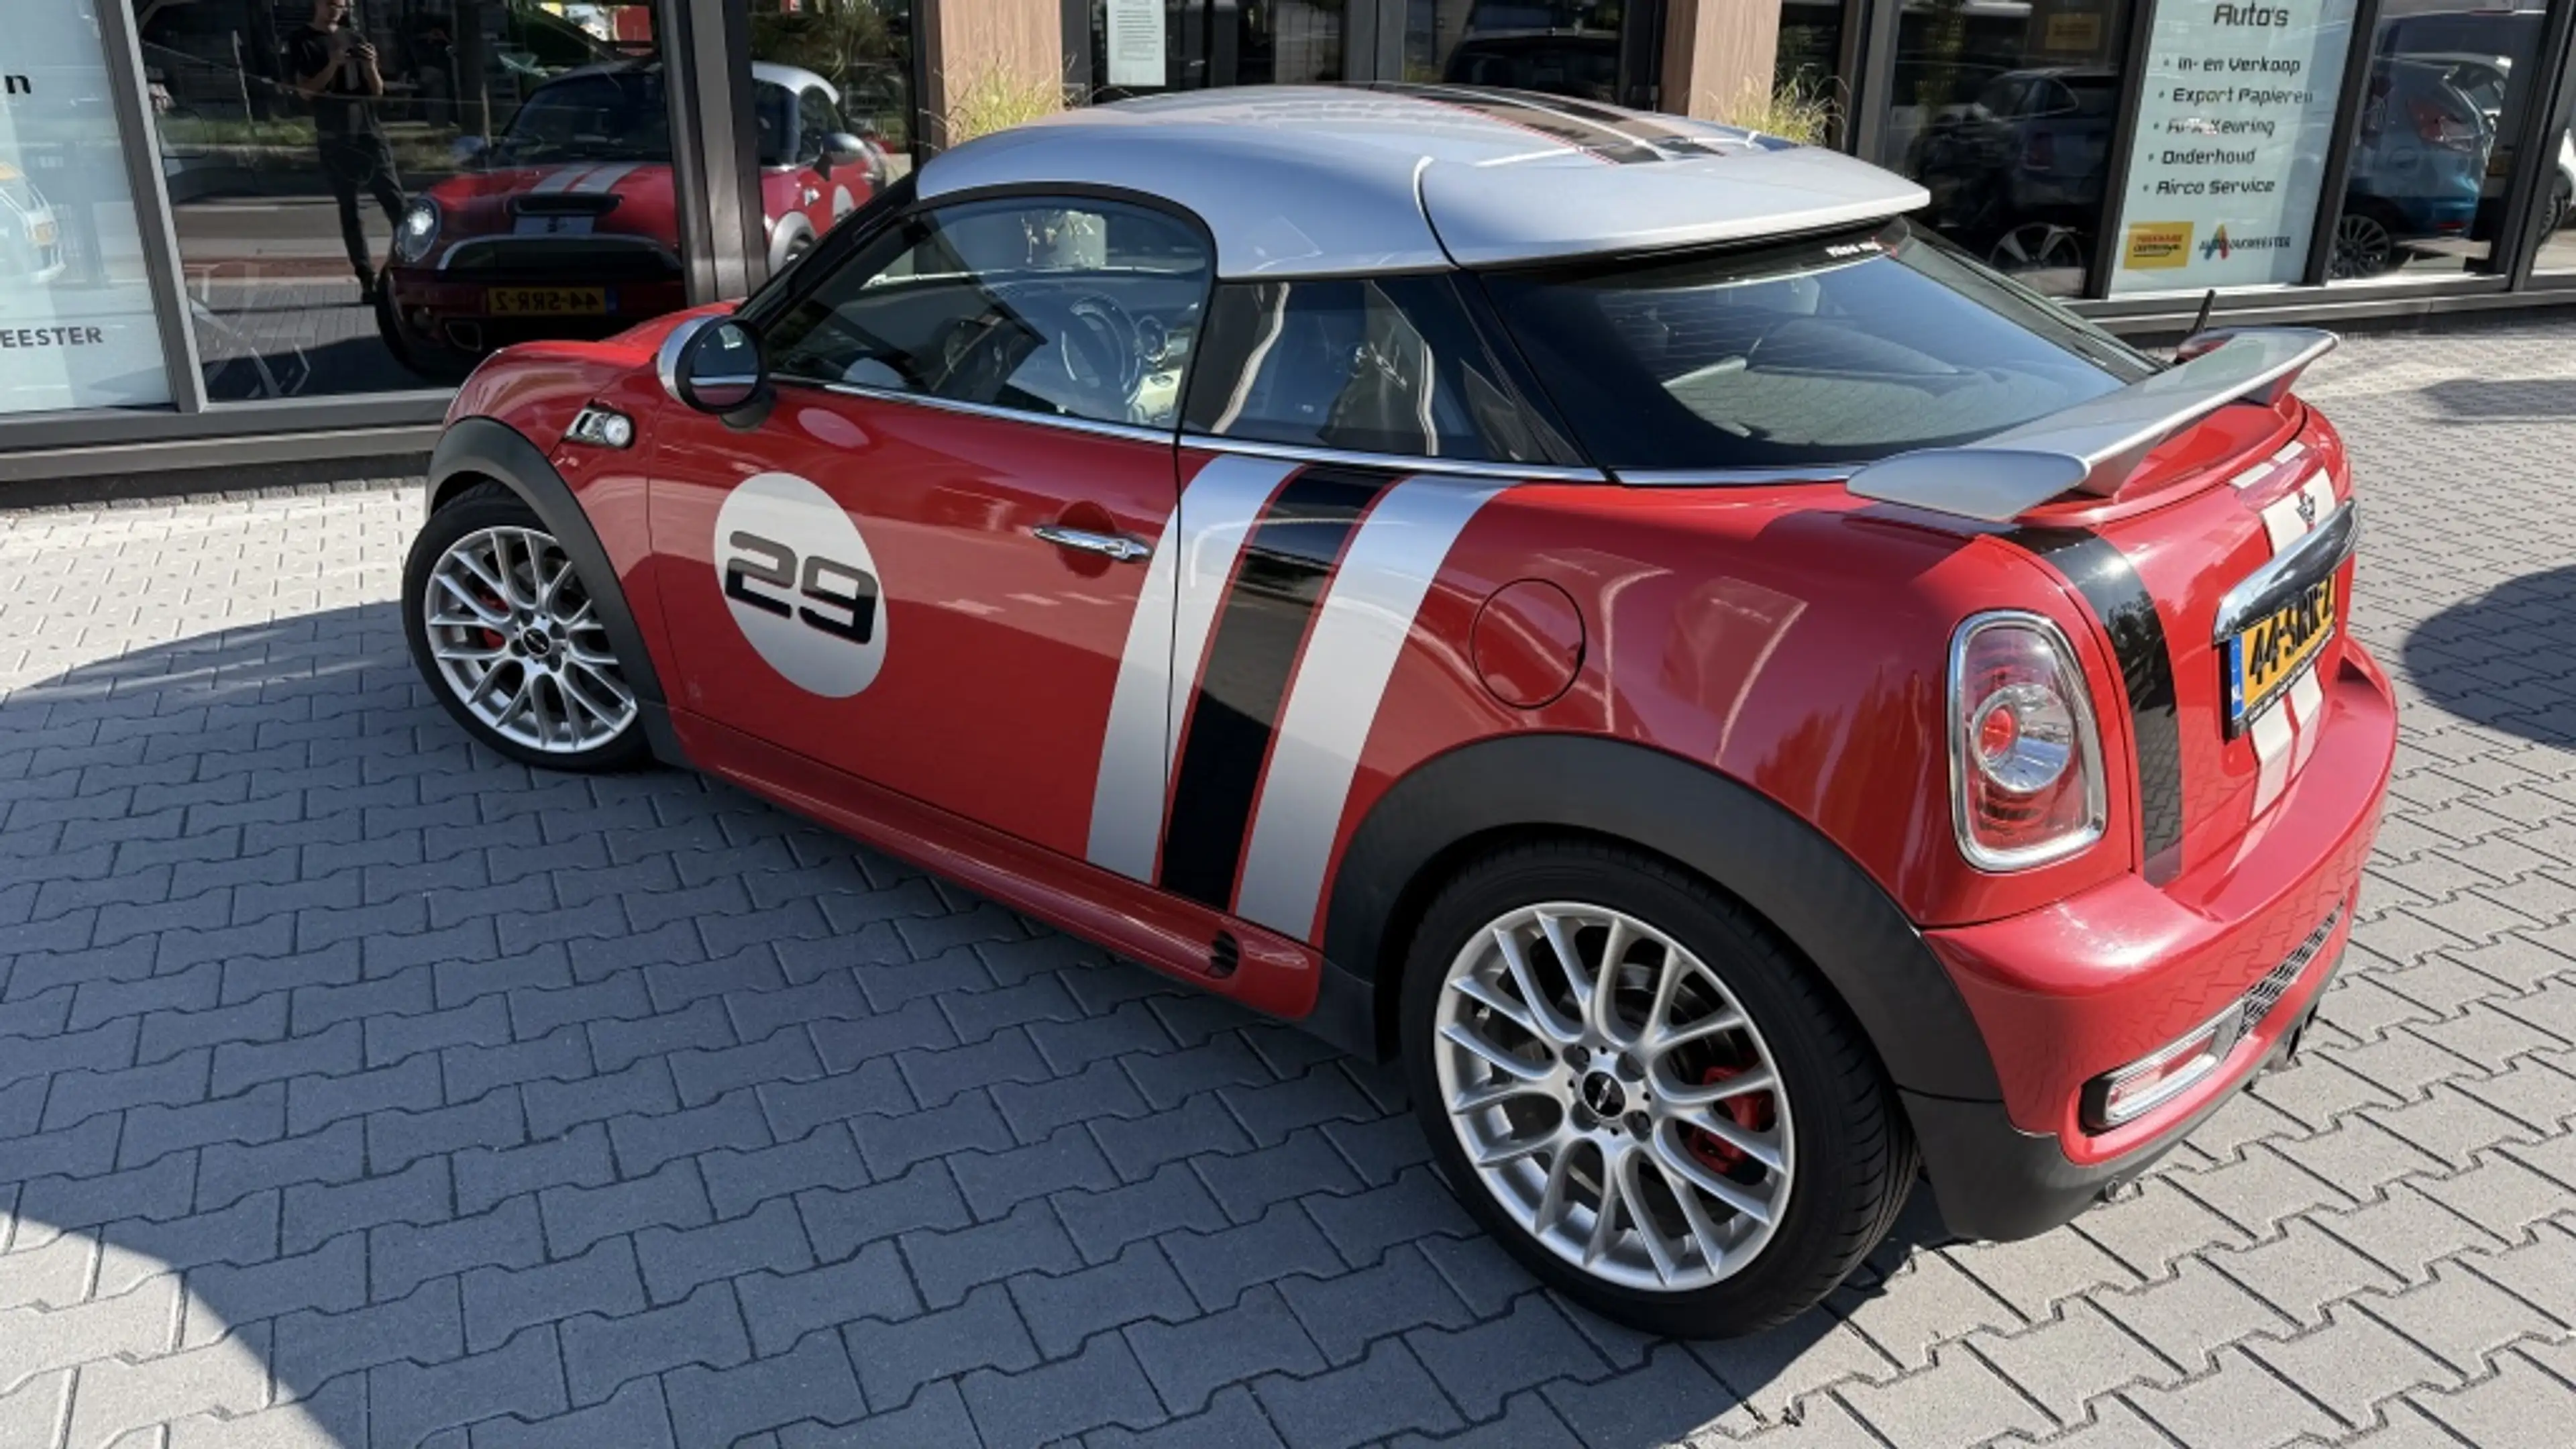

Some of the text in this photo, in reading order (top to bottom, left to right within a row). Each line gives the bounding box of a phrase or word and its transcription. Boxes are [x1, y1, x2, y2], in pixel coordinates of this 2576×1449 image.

[2213, 2, 2290, 27] Auto's
[2203, 58, 2224, 72] en
[2229, 56, 2301, 77] Verkoop
[2172, 87, 2314, 107] Export Papieren
[2160, 148, 2257, 166] Onderhoud
[2155, 178, 2275, 195] Airco Service
[725, 531, 878, 645] 29
